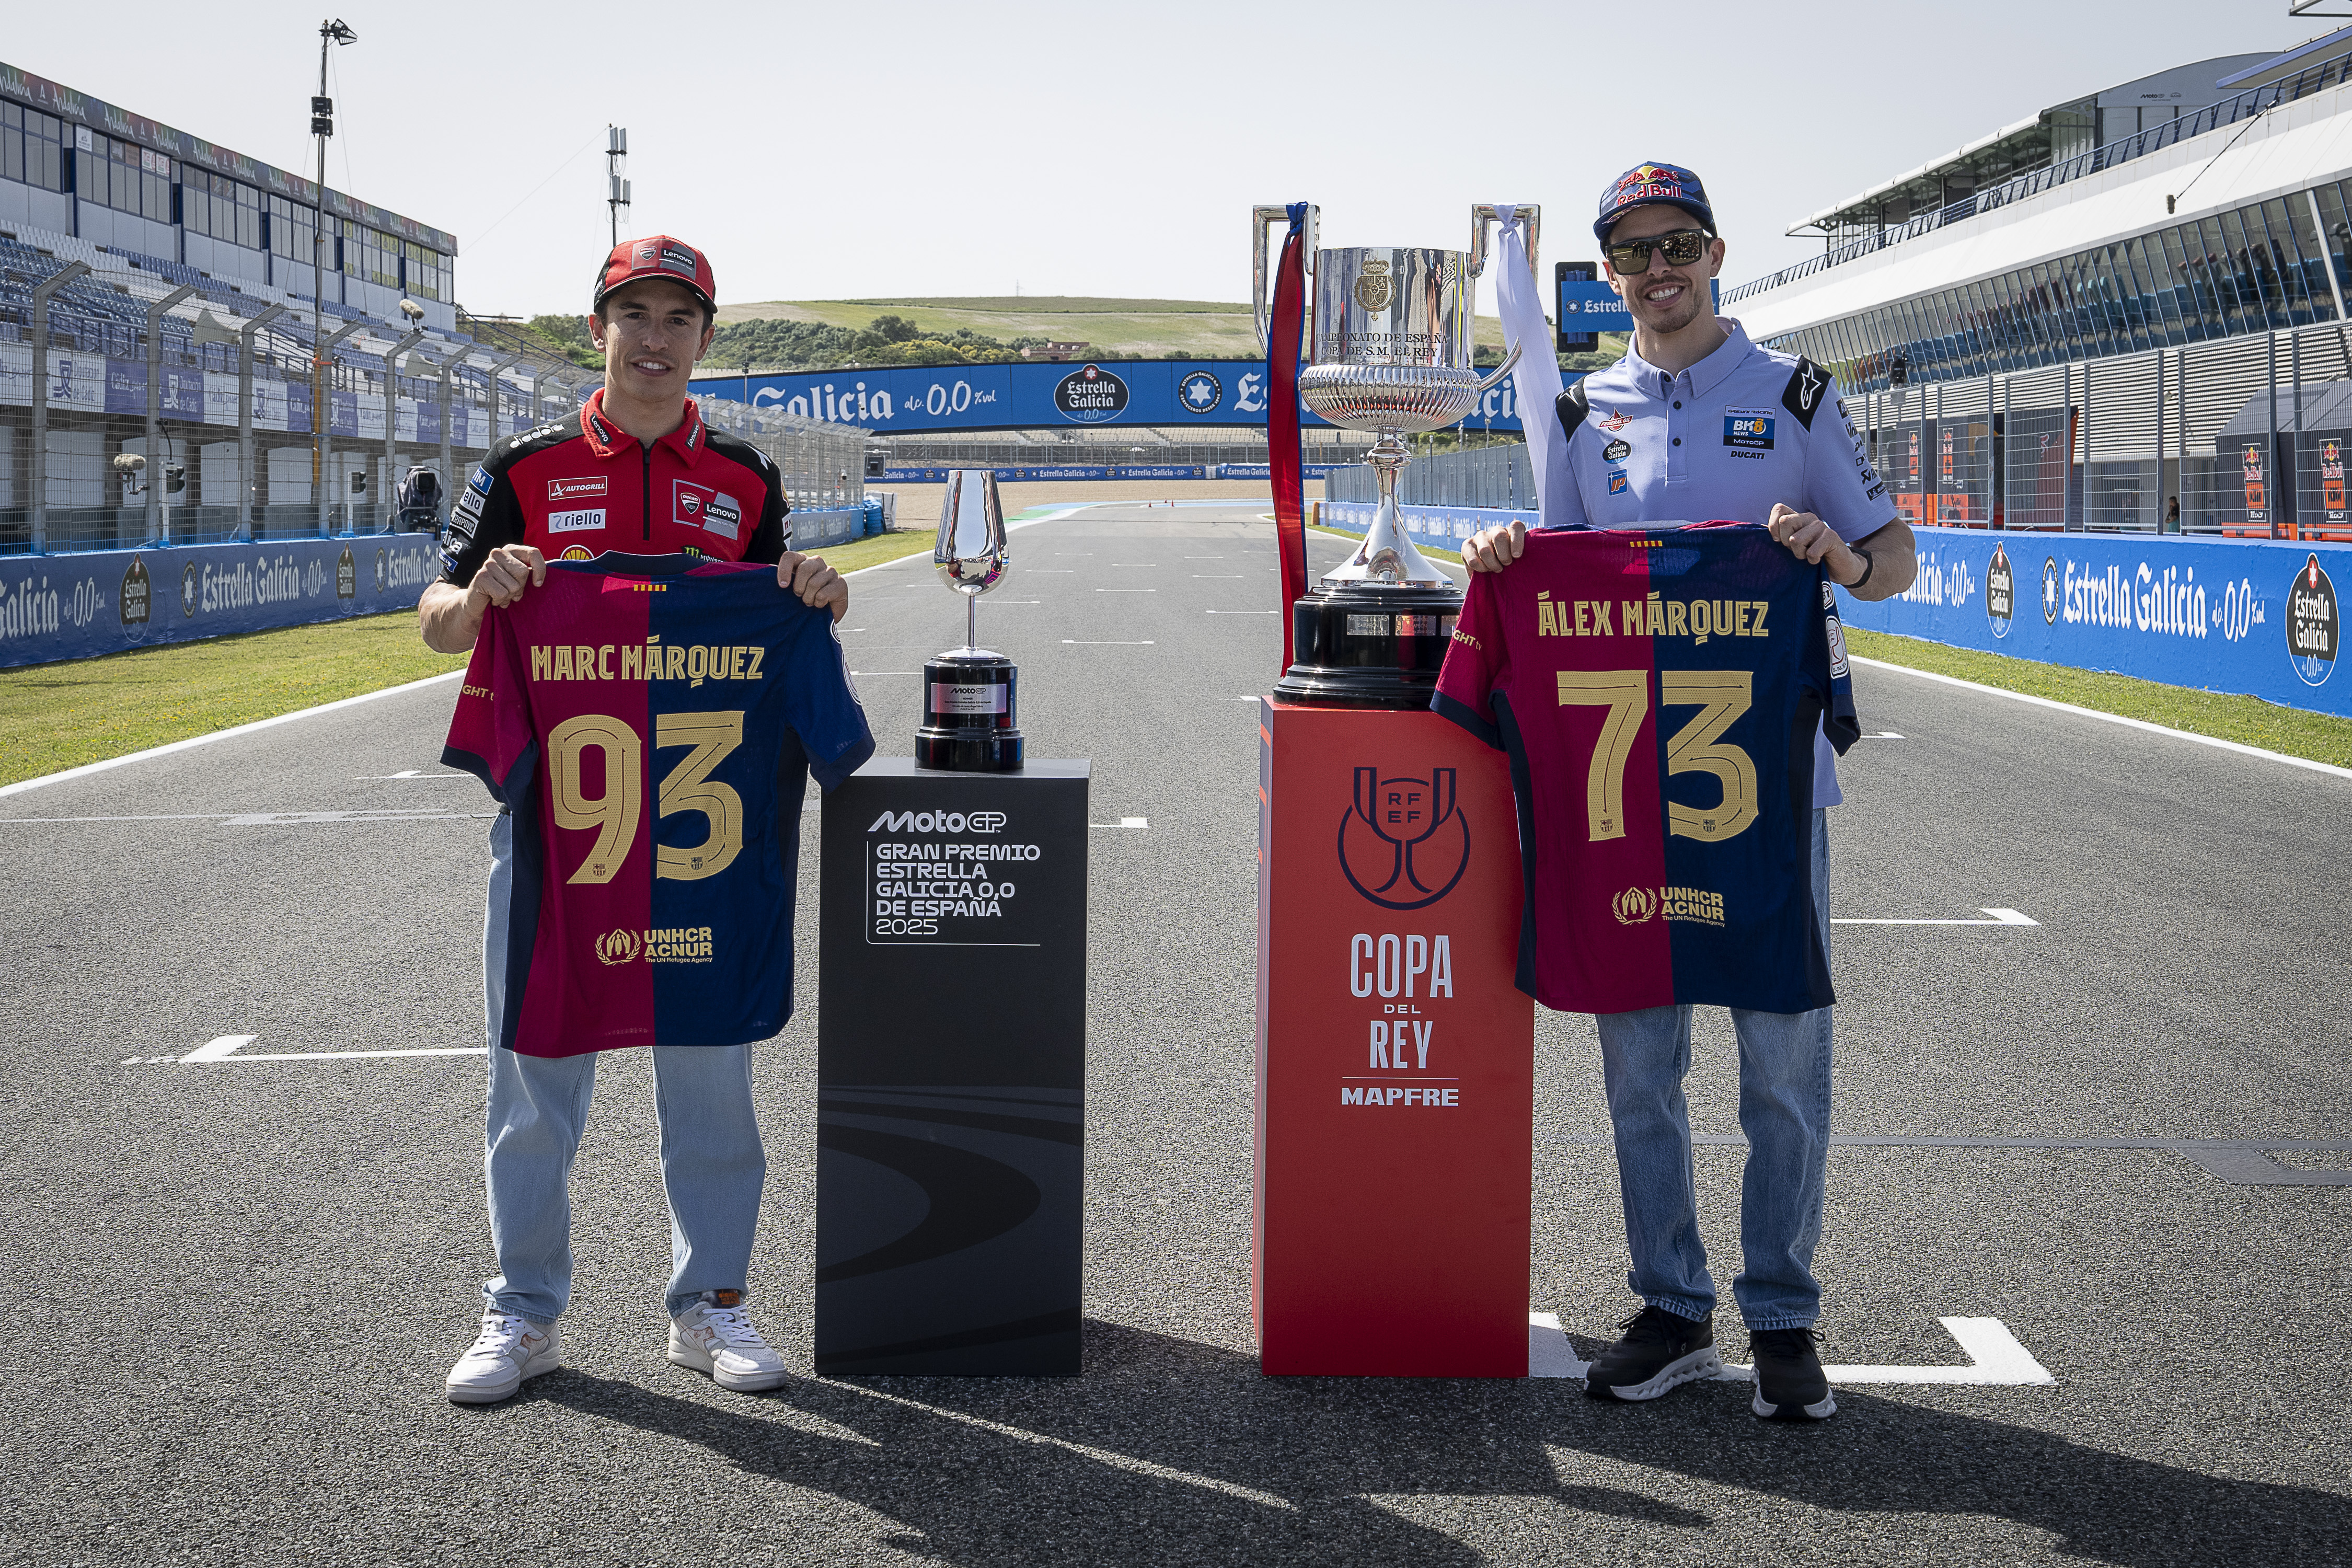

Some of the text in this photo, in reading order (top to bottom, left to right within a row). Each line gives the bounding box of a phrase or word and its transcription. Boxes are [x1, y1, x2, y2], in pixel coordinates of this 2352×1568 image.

[1617, 184, 1681, 206] Red Bull
[664, 249, 693, 264] Lenovo
[1584, 299, 1630, 313] Estrell
[1316, 332, 1448, 344] CAMPEONATO DE ESPAÑA
[1321, 346, 1344, 356] COPA
[1346, 346, 1363, 355] DE
[1394, 347, 1411, 356] EL
[1413, 347, 1438, 356] REY
[1067, 381, 1116, 394] Estrella
[1181, 373, 1198, 387] ESTRELLA
[1198, 372, 1214, 381] GALICIA
[753, 381, 895, 422] Galicia
[927, 380, 971, 416] 0,0
[1069, 393, 1114, 408] Galicia
[1180, 394, 1202, 413] CERVECEROS
[1202, 403, 1216, 412] DESDE
[1084, 409, 1098, 420] 0,0
[591, 416, 609, 443] Lenovo
[687, 424, 700, 447] Lenovo
[1733, 419, 1765, 432] BK8
[510, 424, 564, 448] diadora
[1608, 444, 1627, 454] Estrella
[1608, 451, 1627, 459] Galicia
[1730, 451, 1765, 459] DUCATI
[566, 483, 605, 492] AUTOGRILL
[463, 491, 481, 510] ello
[564, 513, 601, 526] riello
[707, 504, 737, 520] Lenovo
[388, 547, 422, 589] Estrella
[125, 579, 146, 598] Estrella
[202, 562, 253, 613] Estrella
[255, 555, 300, 605] Galicia
[1901, 551, 1943, 607] alicia
[1951, 559, 1967, 608] 0,0
[1990, 568, 2010, 591] Estrella
[74, 577, 95, 627] 0,0
[125, 599, 146, 619] Galicia
[1990, 589, 2009, 614] Galicia
[2062, 559, 2132, 630] Estrella
[2135, 562, 2208, 640] Galicia
[2224, 578, 2251, 642] 0,0
[2294, 589, 2330, 621] Estrella
[1538, 590, 1770, 645] ÁLEX MÁRQUEZ
[2296, 619, 2328, 652] Galicia
[531, 635, 766, 688] MARC MÁRQUEZ
[2307, 653, 2318, 678] 0,0
[1556, 670, 1759, 843] 73
[547, 710, 745, 885] 93
[867, 810, 1007, 833] MotoGP
[877, 843, 1041, 861] GRAN PREMIO
[877, 862, 987, 879] ESTRELLA
[876, 881, 1016, 901] GALICIA 0,0
[1659, 886, 1724, 907] UNHCR
[877, 896, 1002, 917] DE ESPAÑA
[1661, 901, 1725, 921] ACNUR
[876, 919, 939, 935] 2025
[1706, 919, 1725, 928] Agency
[644, 927, 712, 943] UNHCR
[644, 942, 712, 957] ACNUR
[1350, 933, 1454, 998] COPA
[1383, 1004, 1422, 1014] DEL
[1369, 1020, 1434, 1069] REY
[1342, 1087, 1459, 1107] MAPFRE
